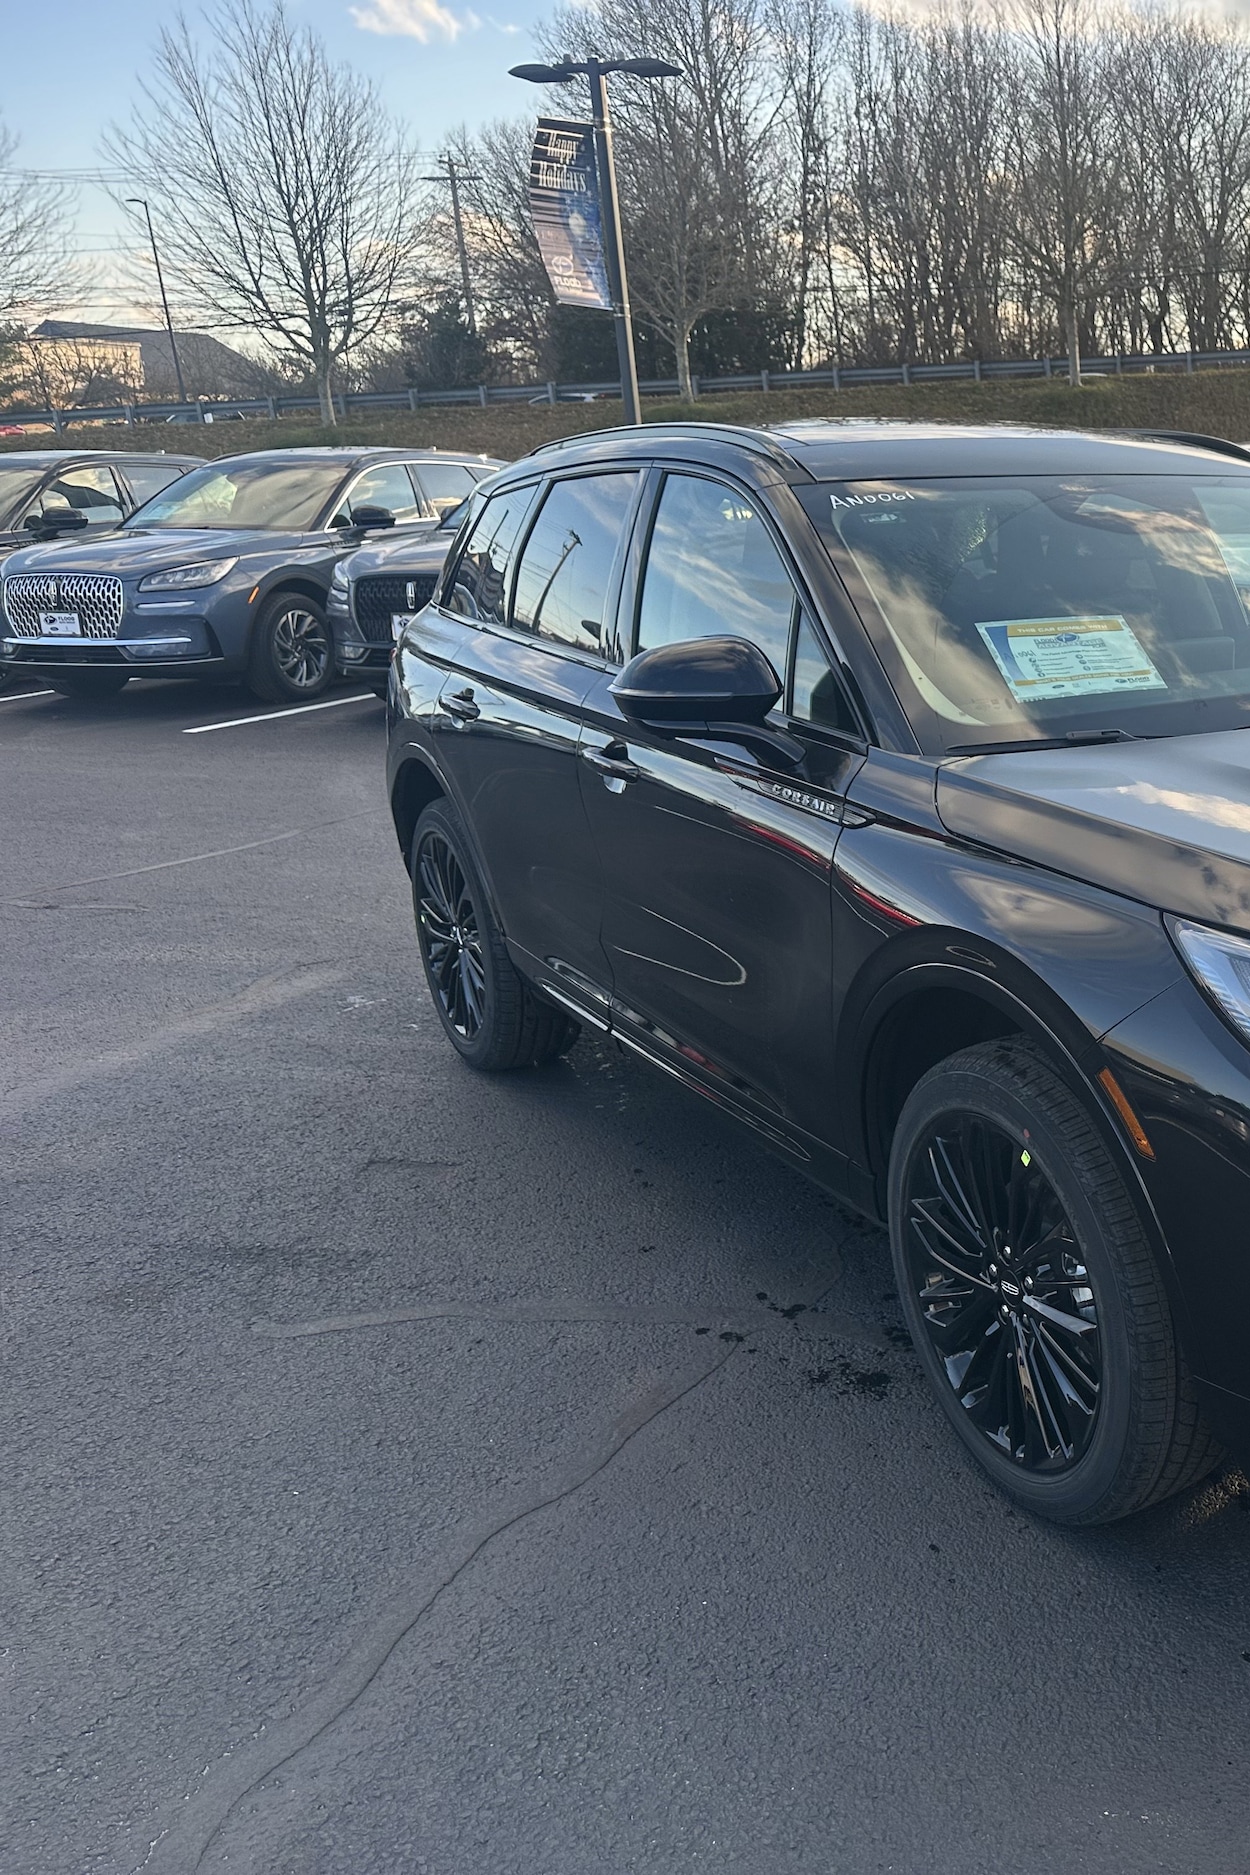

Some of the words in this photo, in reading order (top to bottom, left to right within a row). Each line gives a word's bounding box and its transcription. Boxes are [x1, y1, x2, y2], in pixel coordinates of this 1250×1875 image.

[547, 132, 578, 165] Happy
[538, 161, 587, 192] Holidays
[772, 784, 835, 815] CORSAIR
